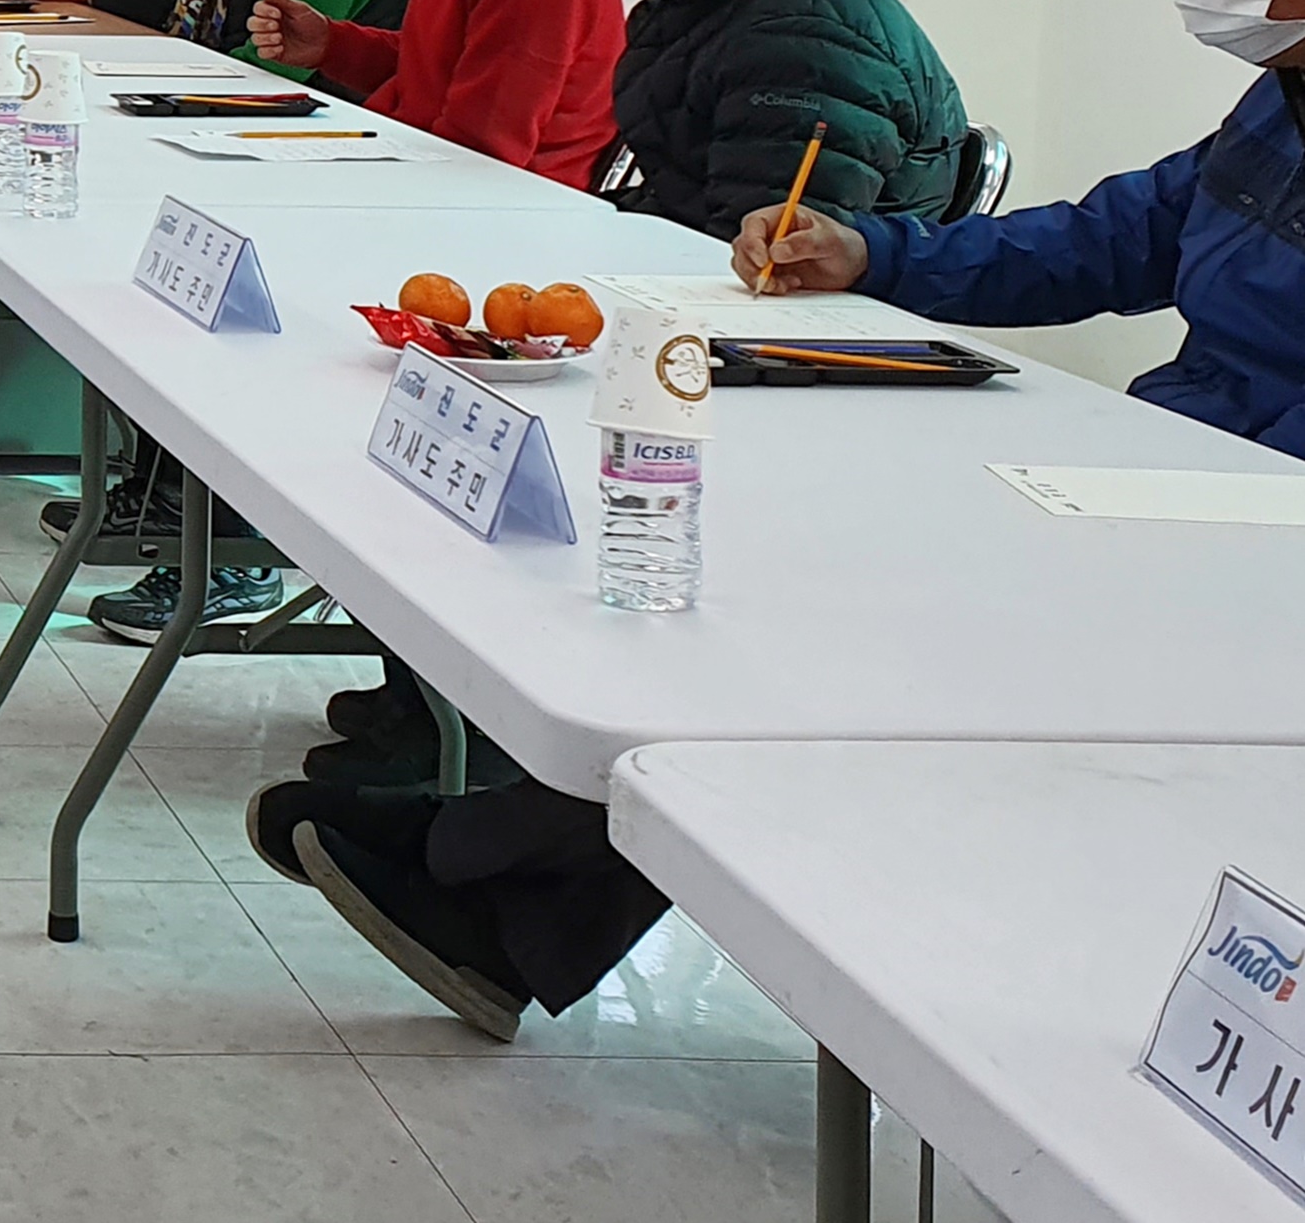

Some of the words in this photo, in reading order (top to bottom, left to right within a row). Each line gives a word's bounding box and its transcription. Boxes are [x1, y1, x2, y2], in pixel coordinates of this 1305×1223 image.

[386, 419, 441, 479] 가사도
[447, 459, 487, 512] 주민
[1207, 925, 1282, 993] Jindo
